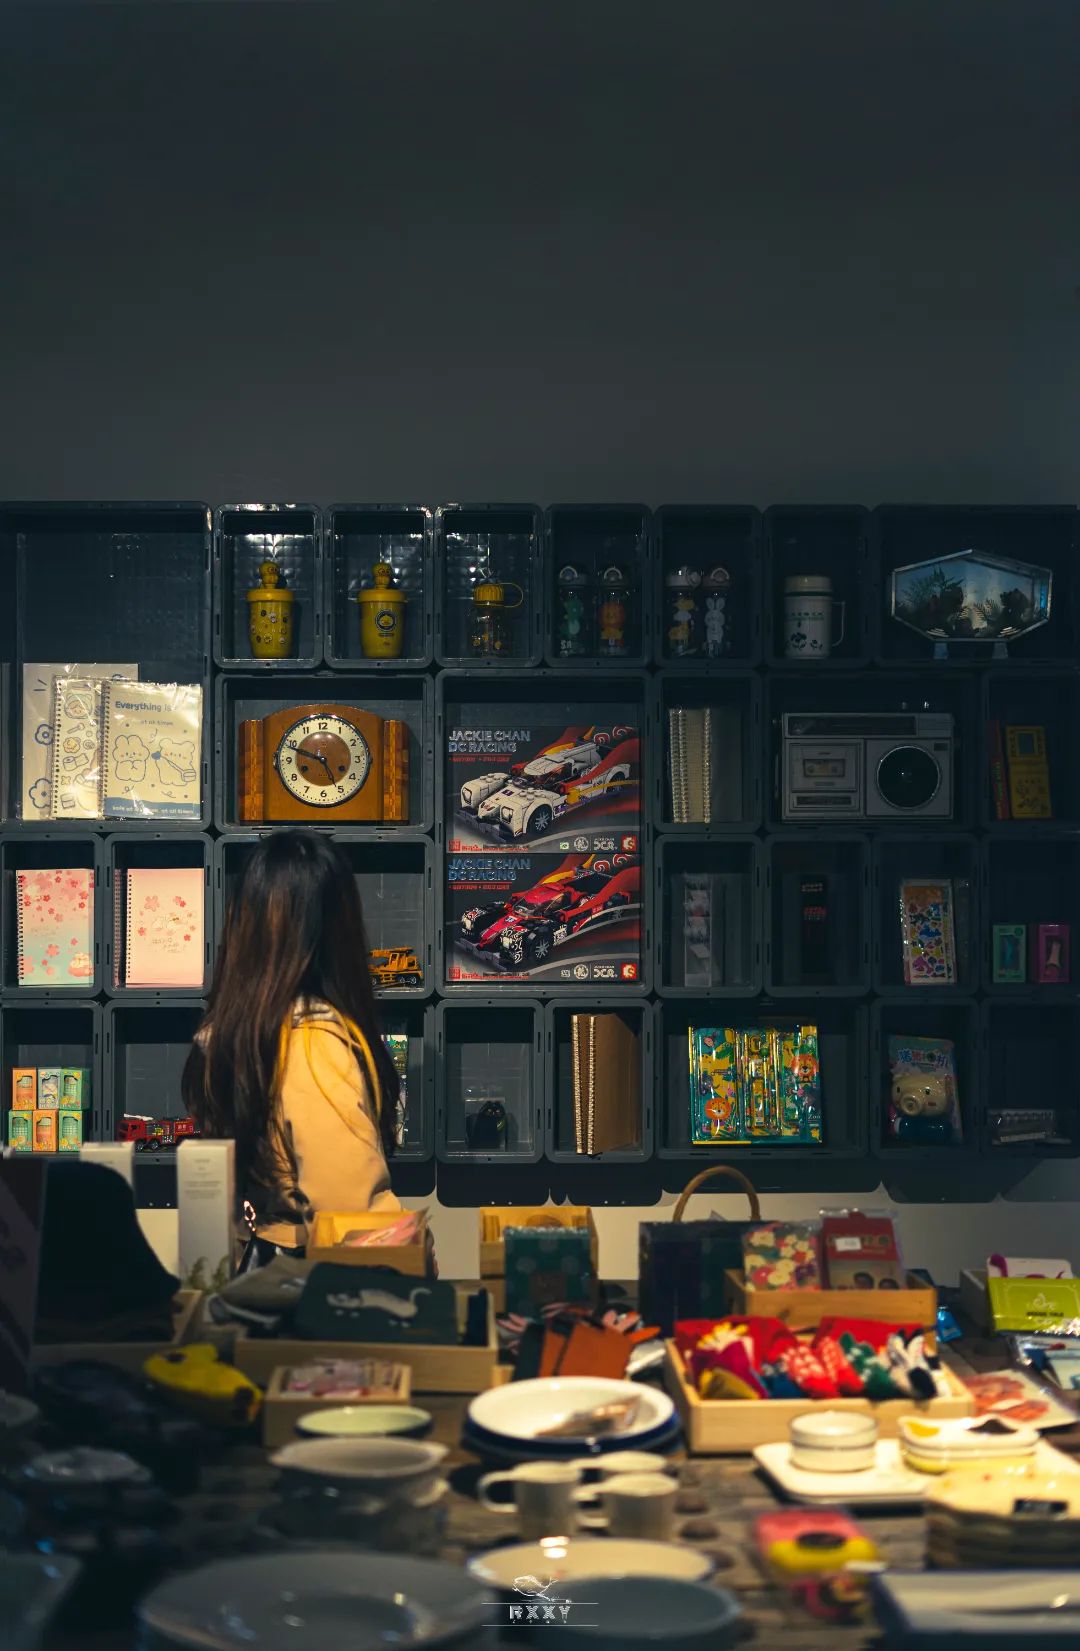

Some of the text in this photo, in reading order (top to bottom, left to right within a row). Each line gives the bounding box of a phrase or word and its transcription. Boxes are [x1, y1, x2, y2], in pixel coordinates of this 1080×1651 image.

[115, 701, 162, 712] Everything
[318, 722, 328, 730] 12
[449, 731, 531, 742] JACKIE CHAN
[289, 740, 297, 748] 10
[448, 742, 517, 753] DC RACING
[449, 859, 531, 870] JACKIE CHAN
[468, 870, 517, 881] RACING
